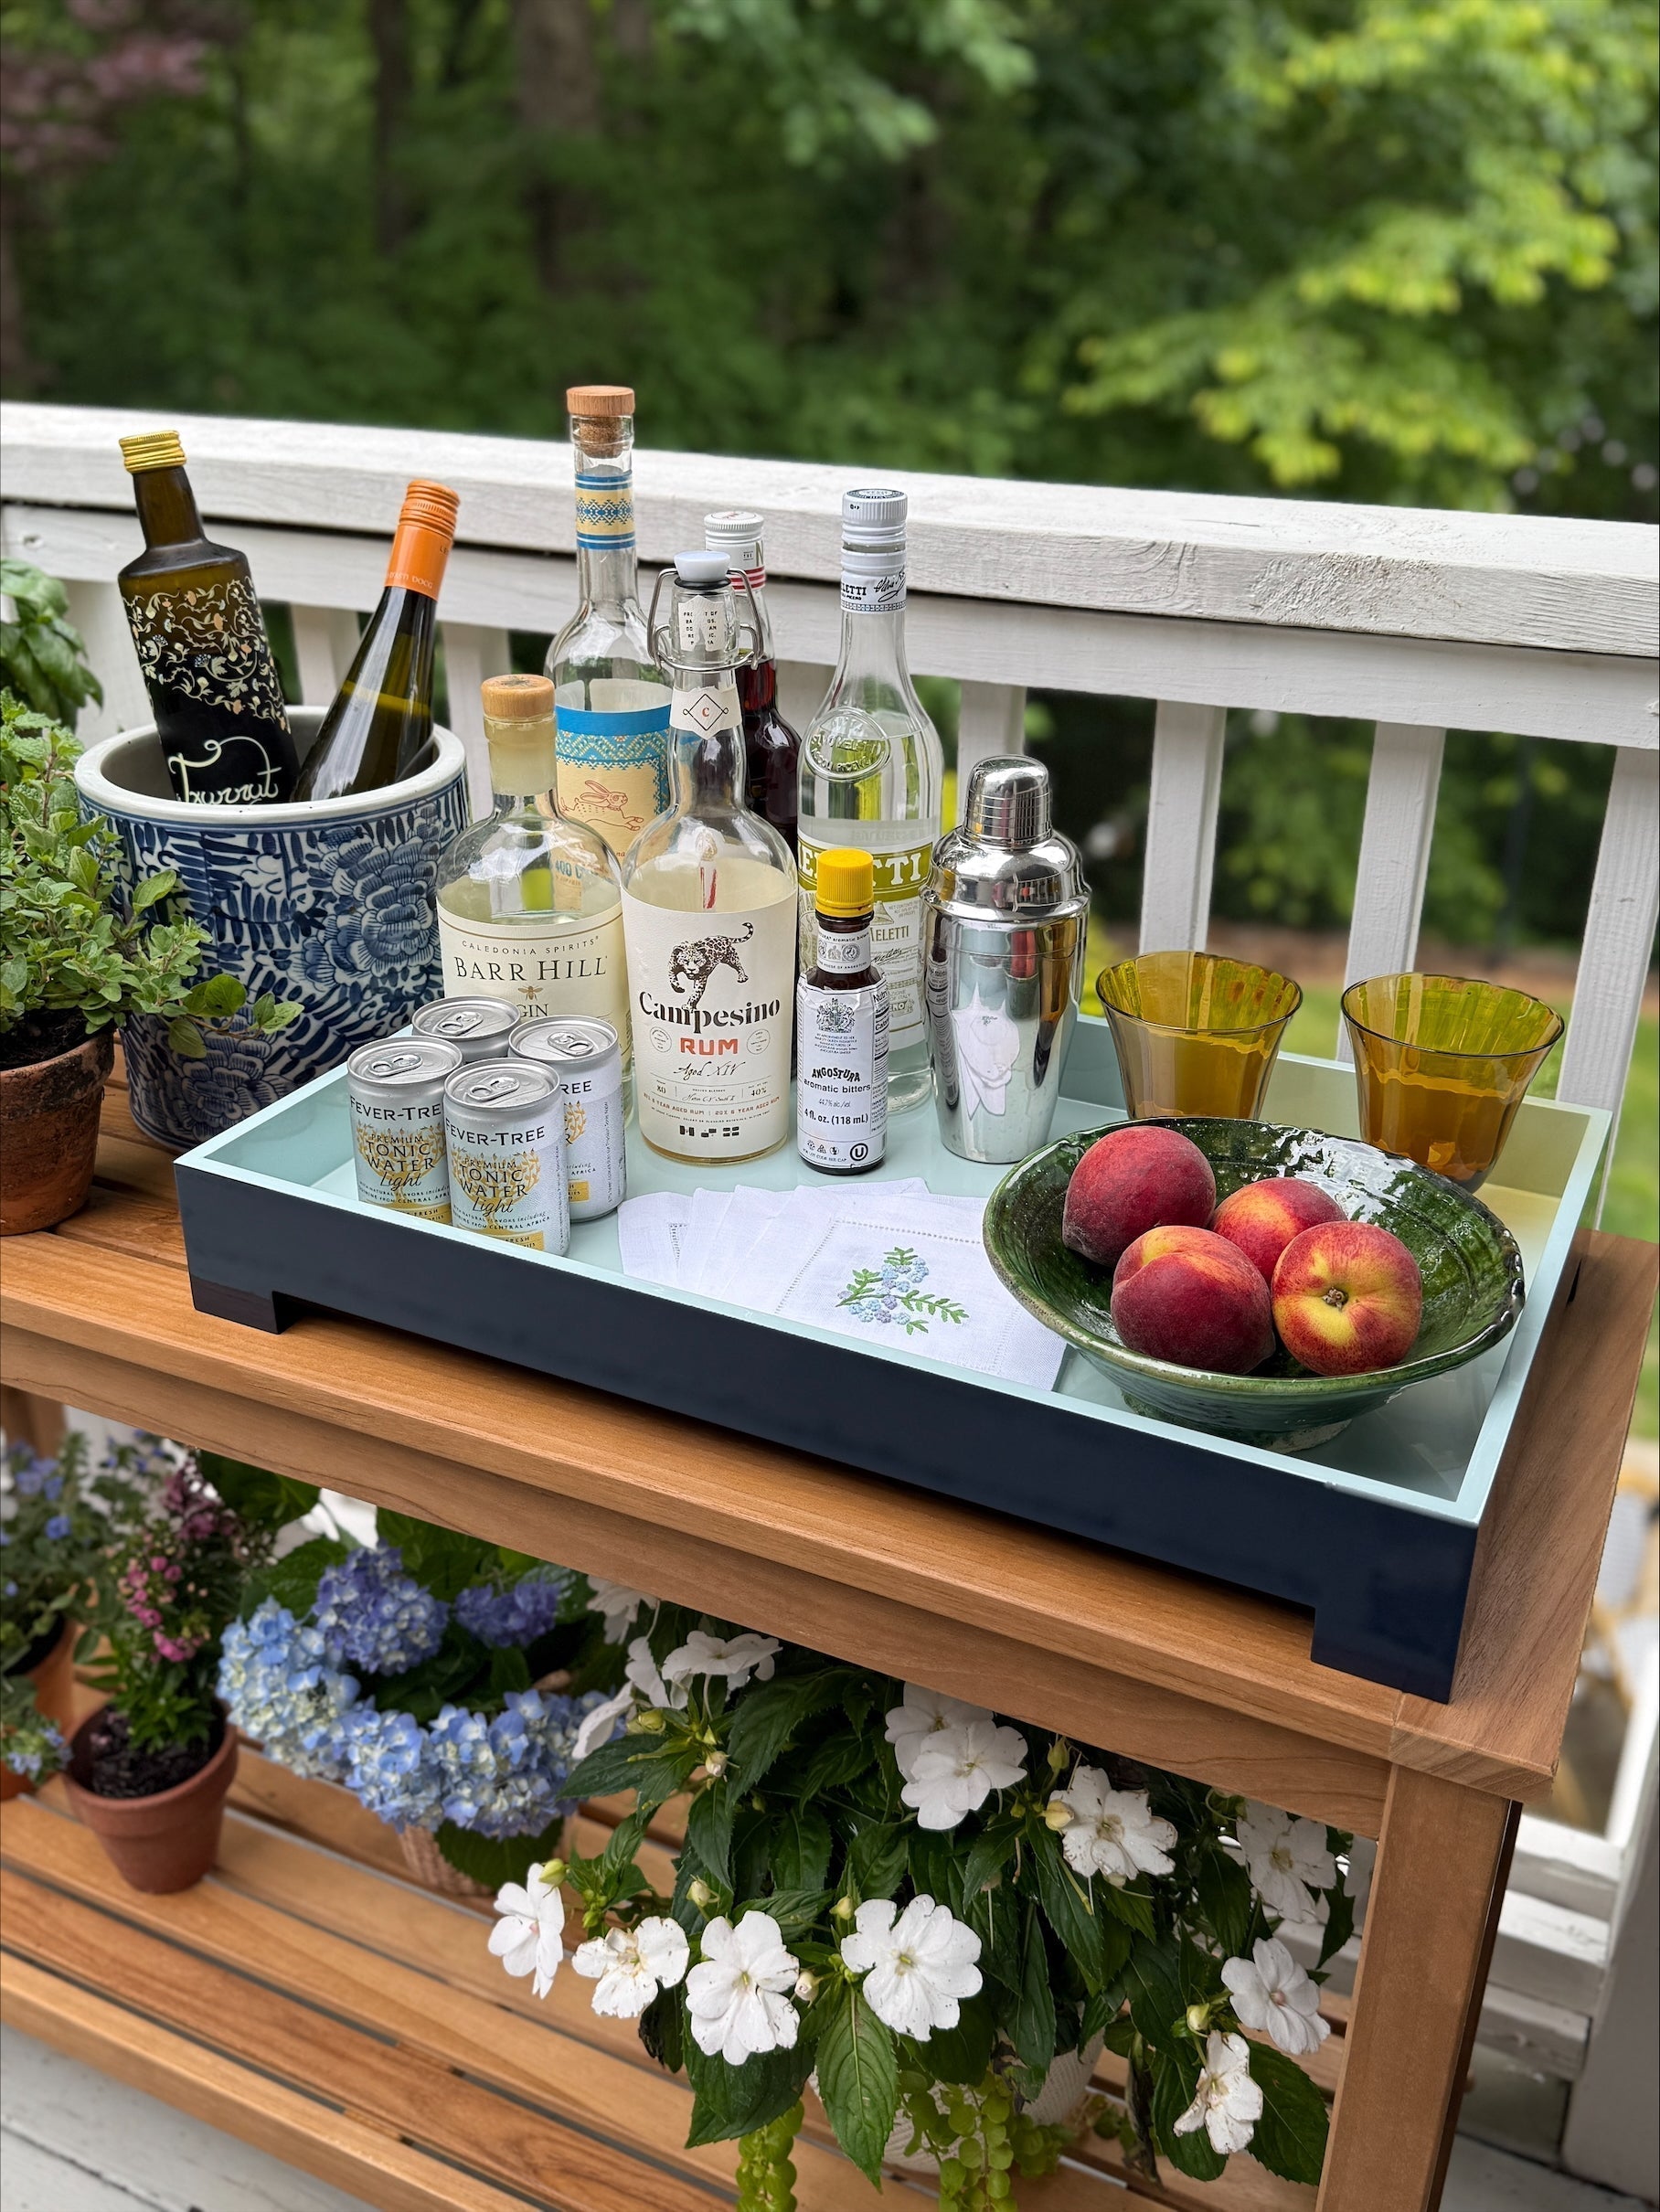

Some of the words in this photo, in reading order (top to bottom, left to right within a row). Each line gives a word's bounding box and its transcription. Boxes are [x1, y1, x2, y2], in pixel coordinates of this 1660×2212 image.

[702, 707, 710, 718] C
[462, 940, 537, 955] CALEDONIA
[454, 956, 527, 982] BARR
[537, 957, 607, 981] HILL
[516, 1004, 548, 1018] GIN
[639, 991, 782, 1035] Campesino
[680, 1037, 739, 1056] RUM
[673, 1061, 712, 1081] Aged
[812, 1067, 861, 1082] ANGOSTURA
[804, 1079, 839, 1093] aromatic
[842, 1084, 871, 1093] bitters
[350, 1095, 442, 1122] FEVER-TRE
[672, 1105, 687, 1113] AGED
[817, 1114, 830, 1123] oz.
[831, 1115, 851, 1125] (118
[371, 1133, 424, 1144] PREMIUM
[445, 1118, 546, 1146] FEVER-TREE
[366, 1140, 431, 1157] TONIC
[855, 1147, 866, 1158] U
[366, 1154, 435, 1172] WATER
[464, 1157, 516, 1169] PREMIUM
[380, 1171, 421, 1192] Light
[459, 1164, 523, 1184] TONIC
[460, 1178, 528, 1198] WATER
[473, 1196, 514, 1218] Light
[527, 1216, 549, 1228] AFRICA
